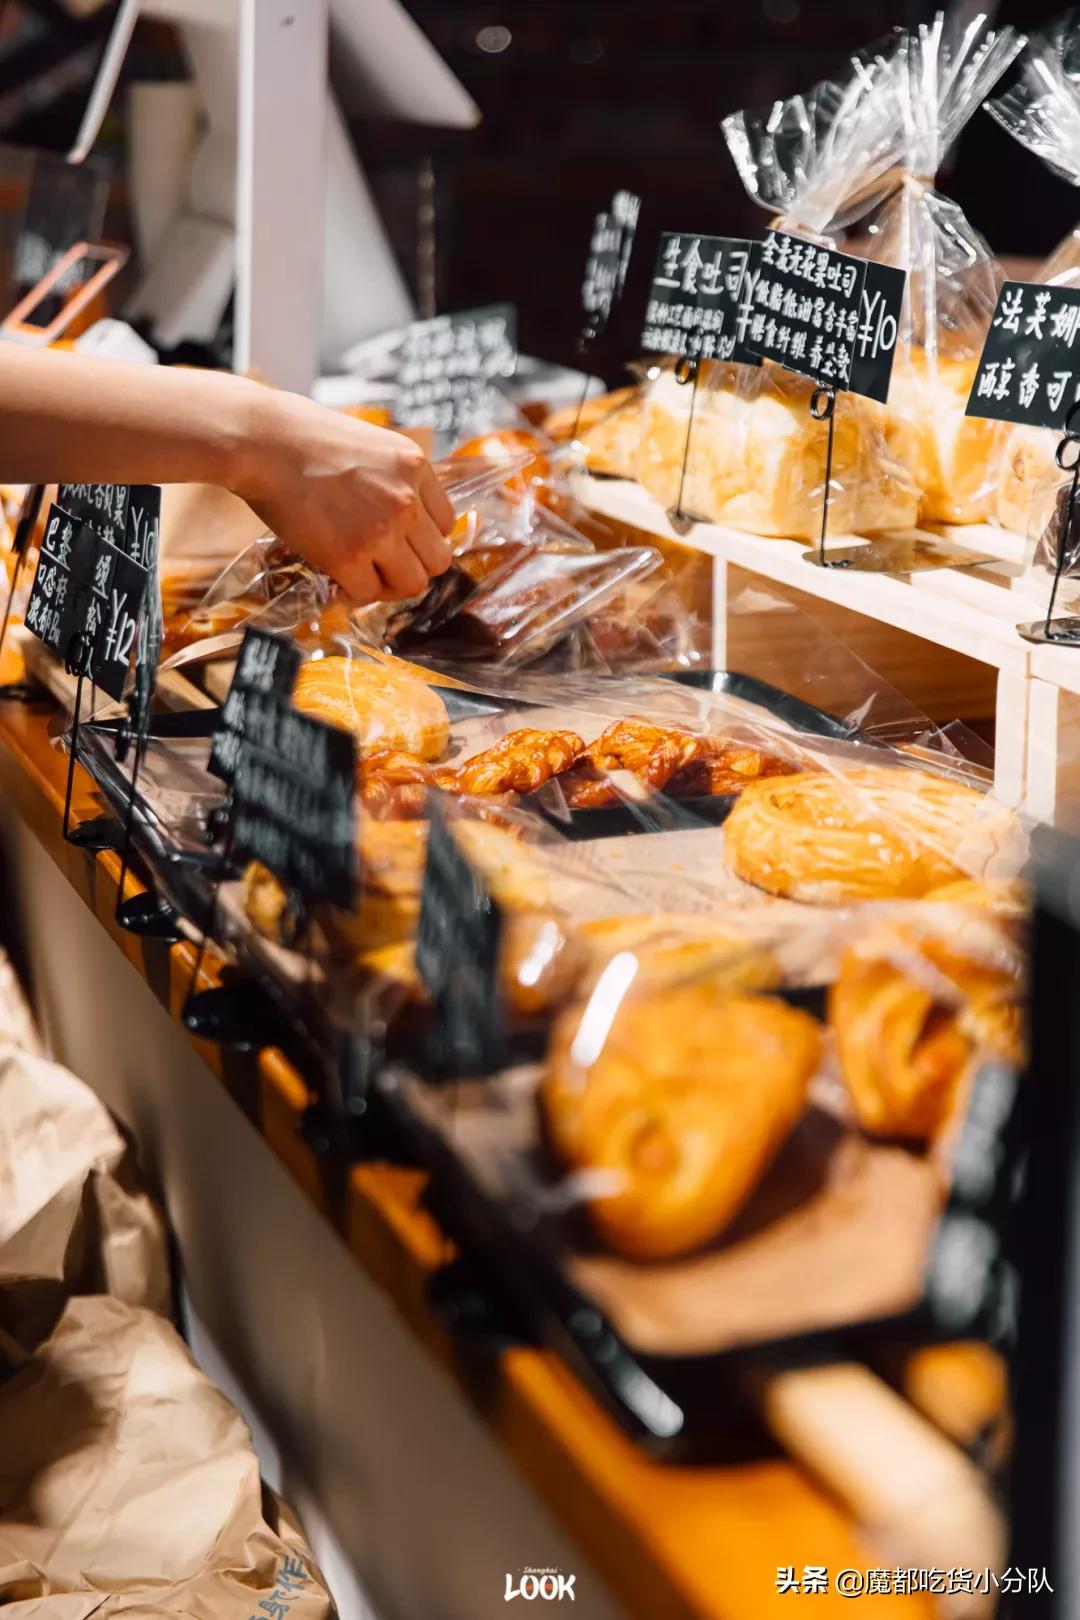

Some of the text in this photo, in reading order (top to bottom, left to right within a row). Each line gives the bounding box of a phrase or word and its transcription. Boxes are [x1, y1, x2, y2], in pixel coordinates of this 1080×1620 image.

[653, 236, 749, 302] 生食吐司
[762, 231, 857, 298] 全麦无花果吐司
[857, 289, 897, 359] ¥10
